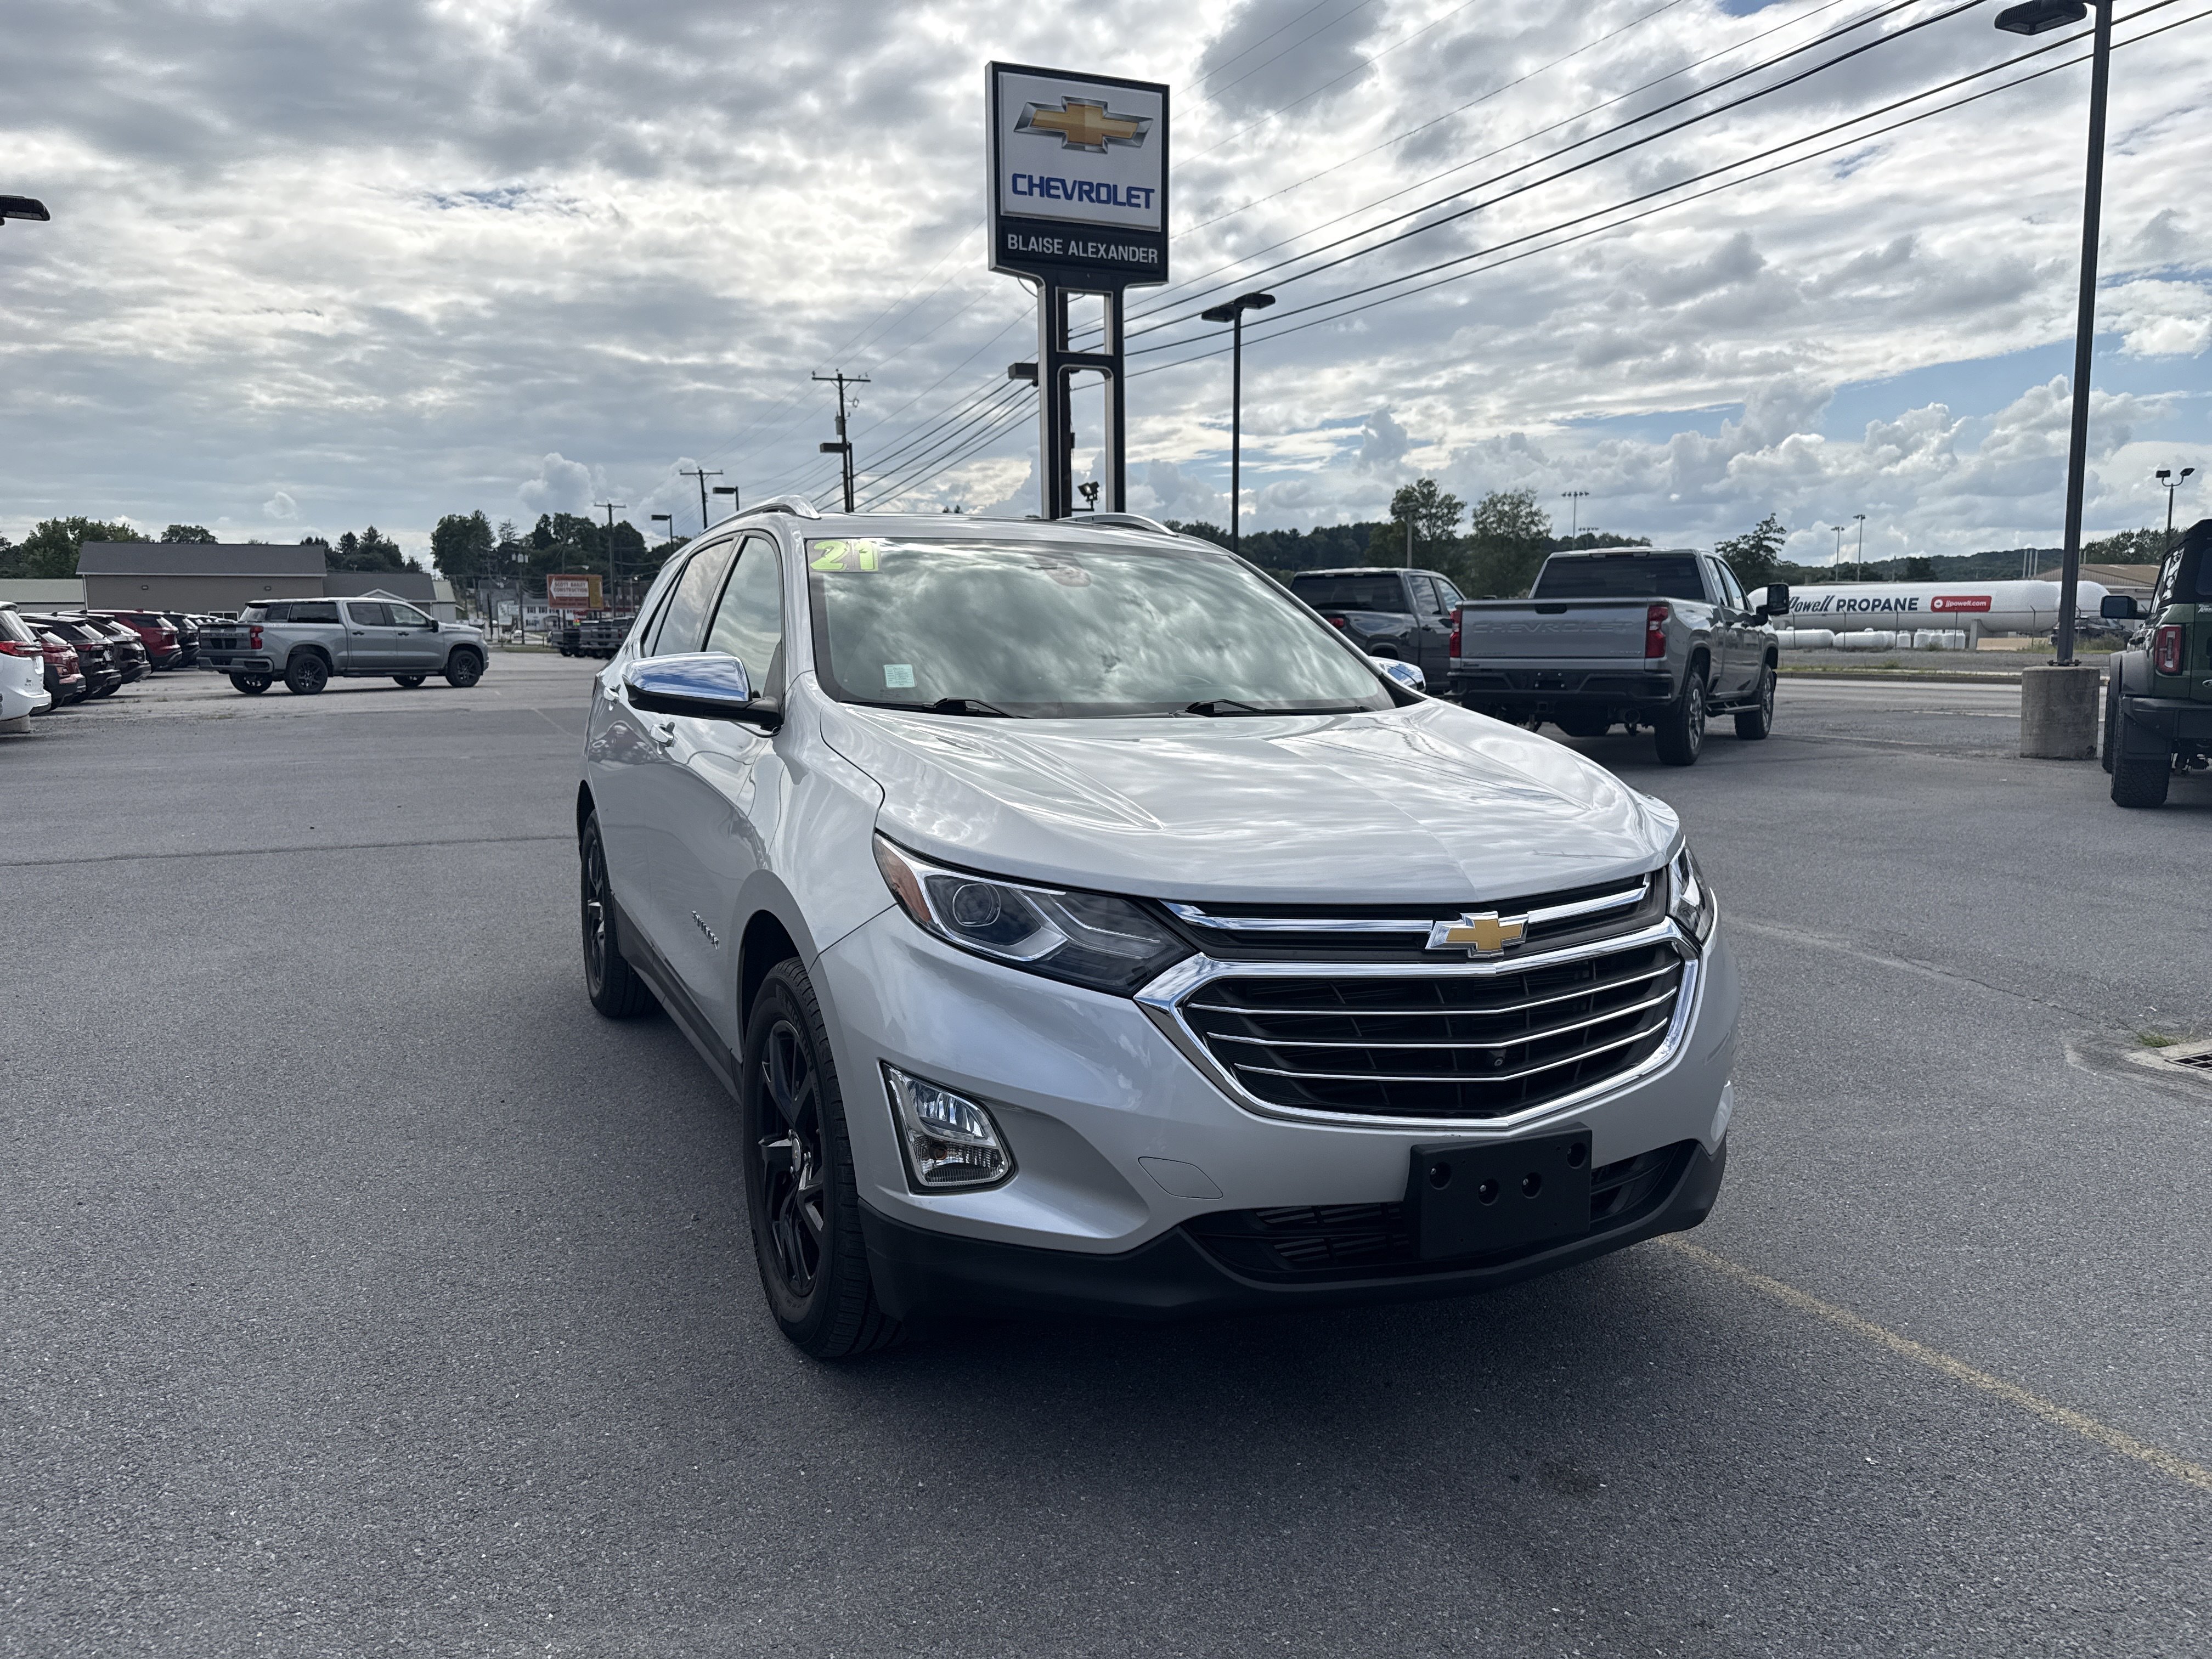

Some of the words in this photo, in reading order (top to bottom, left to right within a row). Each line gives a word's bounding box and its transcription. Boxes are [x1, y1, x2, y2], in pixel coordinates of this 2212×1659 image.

[1012, 173, 1155, 209] CHEVROLET
[1007, 234, 1063, 255] BLAISE
[1068, 240, 1158, 264] ALEXANDER
[810, 540, 878, 571] 21
[1788, 595, 1835, 612] Powell
[1836, 597, 1919, 612] PROPANE
[1472, 619, 1633, 633] CHEVROLET
